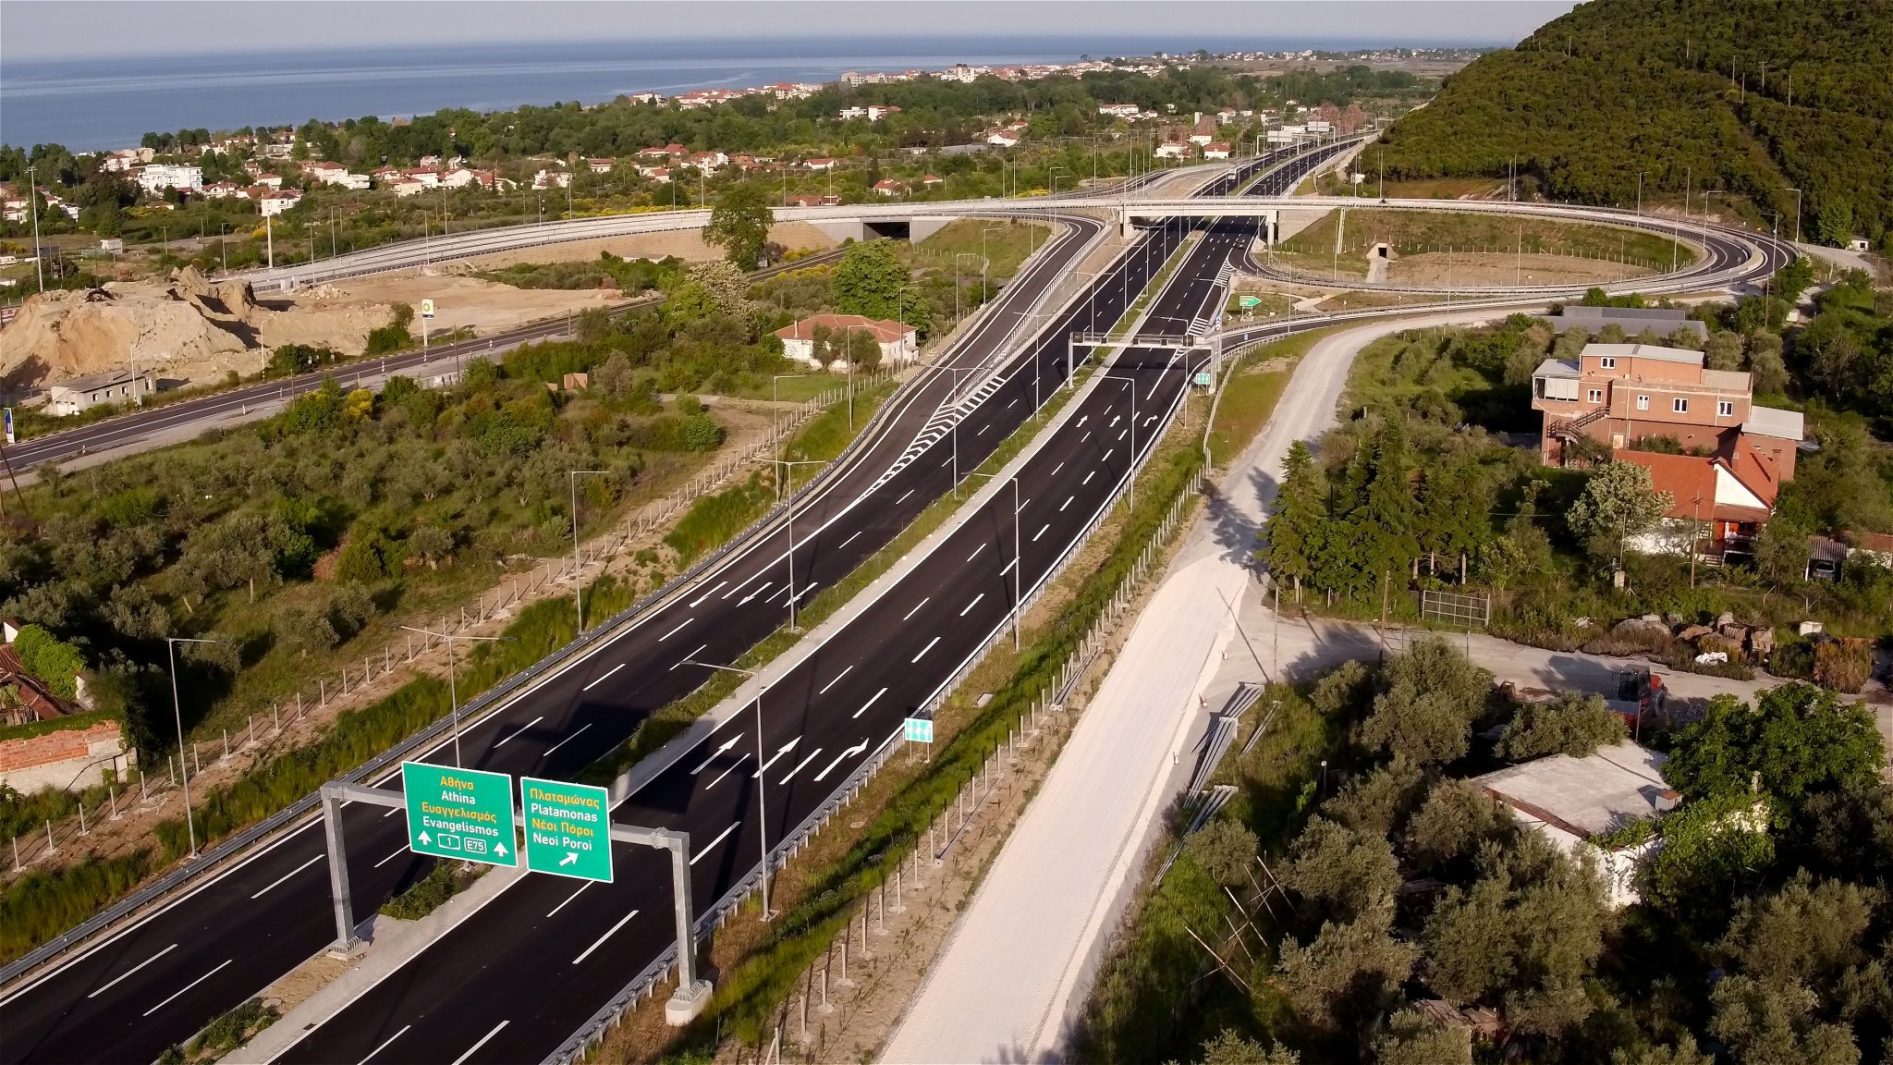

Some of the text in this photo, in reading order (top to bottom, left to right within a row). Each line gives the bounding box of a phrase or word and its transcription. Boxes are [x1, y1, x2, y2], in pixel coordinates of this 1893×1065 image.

[440, 776, 474, 791] Αθήνα
[441, 791, 476, 805] Athina
[529, 788, 600, 810] Πλαταμώνας
[421, 802, 497, 824] Ευαγγελισμός
[531, 803, 598, 822] Platamonas
[423, 816, 499, 837] Evangelismos
[532, 818, 594, 838] Νέοι Πόροι
[447, 837, 452, 847] 1
[467, 840, 484, 851] E75
[533, 833, 592, 851] Neoi Poroi
